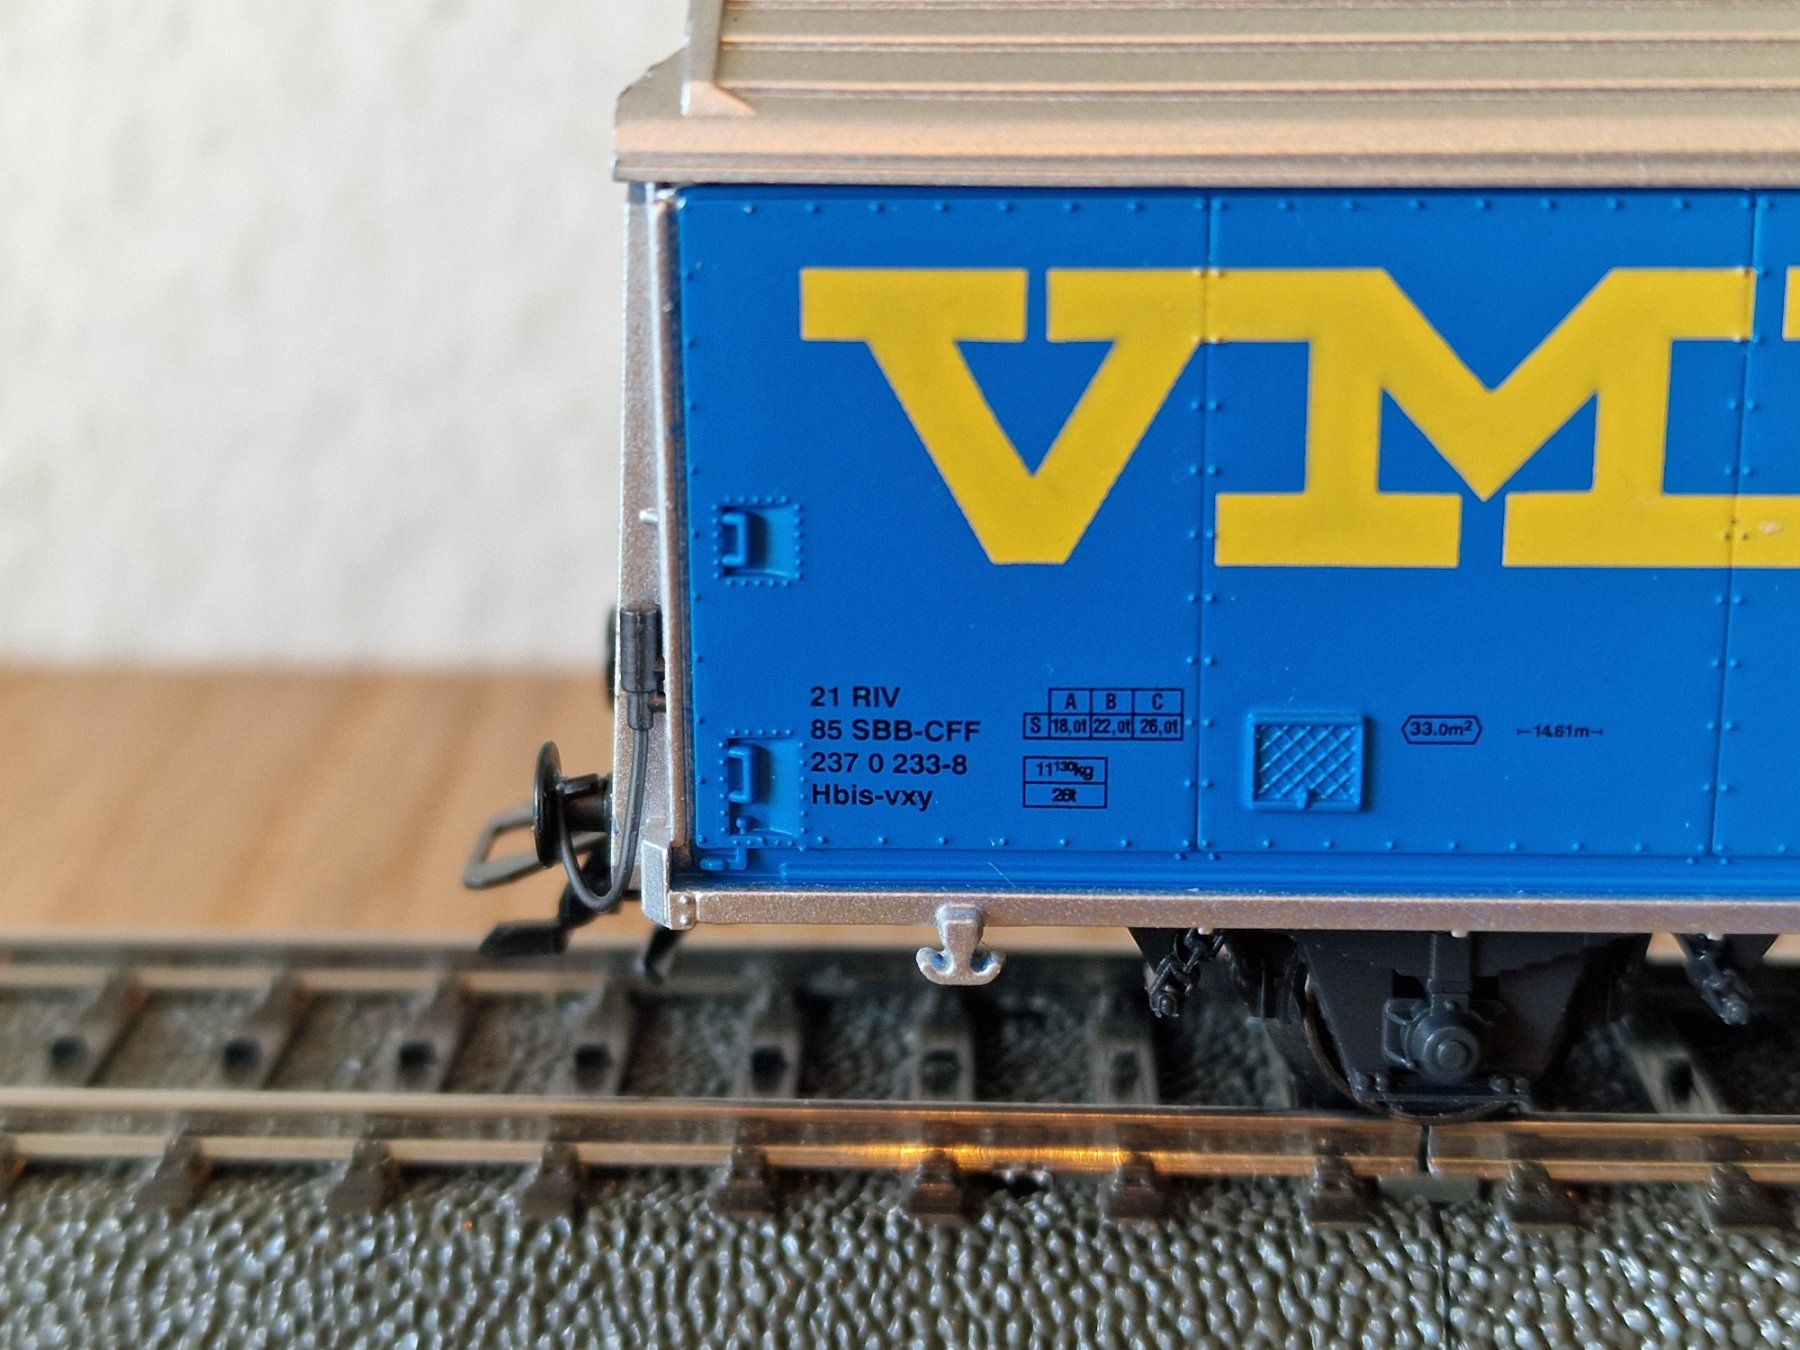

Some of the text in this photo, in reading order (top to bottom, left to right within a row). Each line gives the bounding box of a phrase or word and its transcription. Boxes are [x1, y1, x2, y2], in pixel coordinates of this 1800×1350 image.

[800, 267, 1800, 568] VM
[810, 686, 900, 708] 21 RIV
[1064, 693, 1163, 710] A B C
[810, 719, 981, 742] 85 SBB-CFF
[1030, 716, 1041, 734] S
[810, 752, 968, 775] 237 0 233-8
[812, 784, 933, 812] Hbis-vxy
